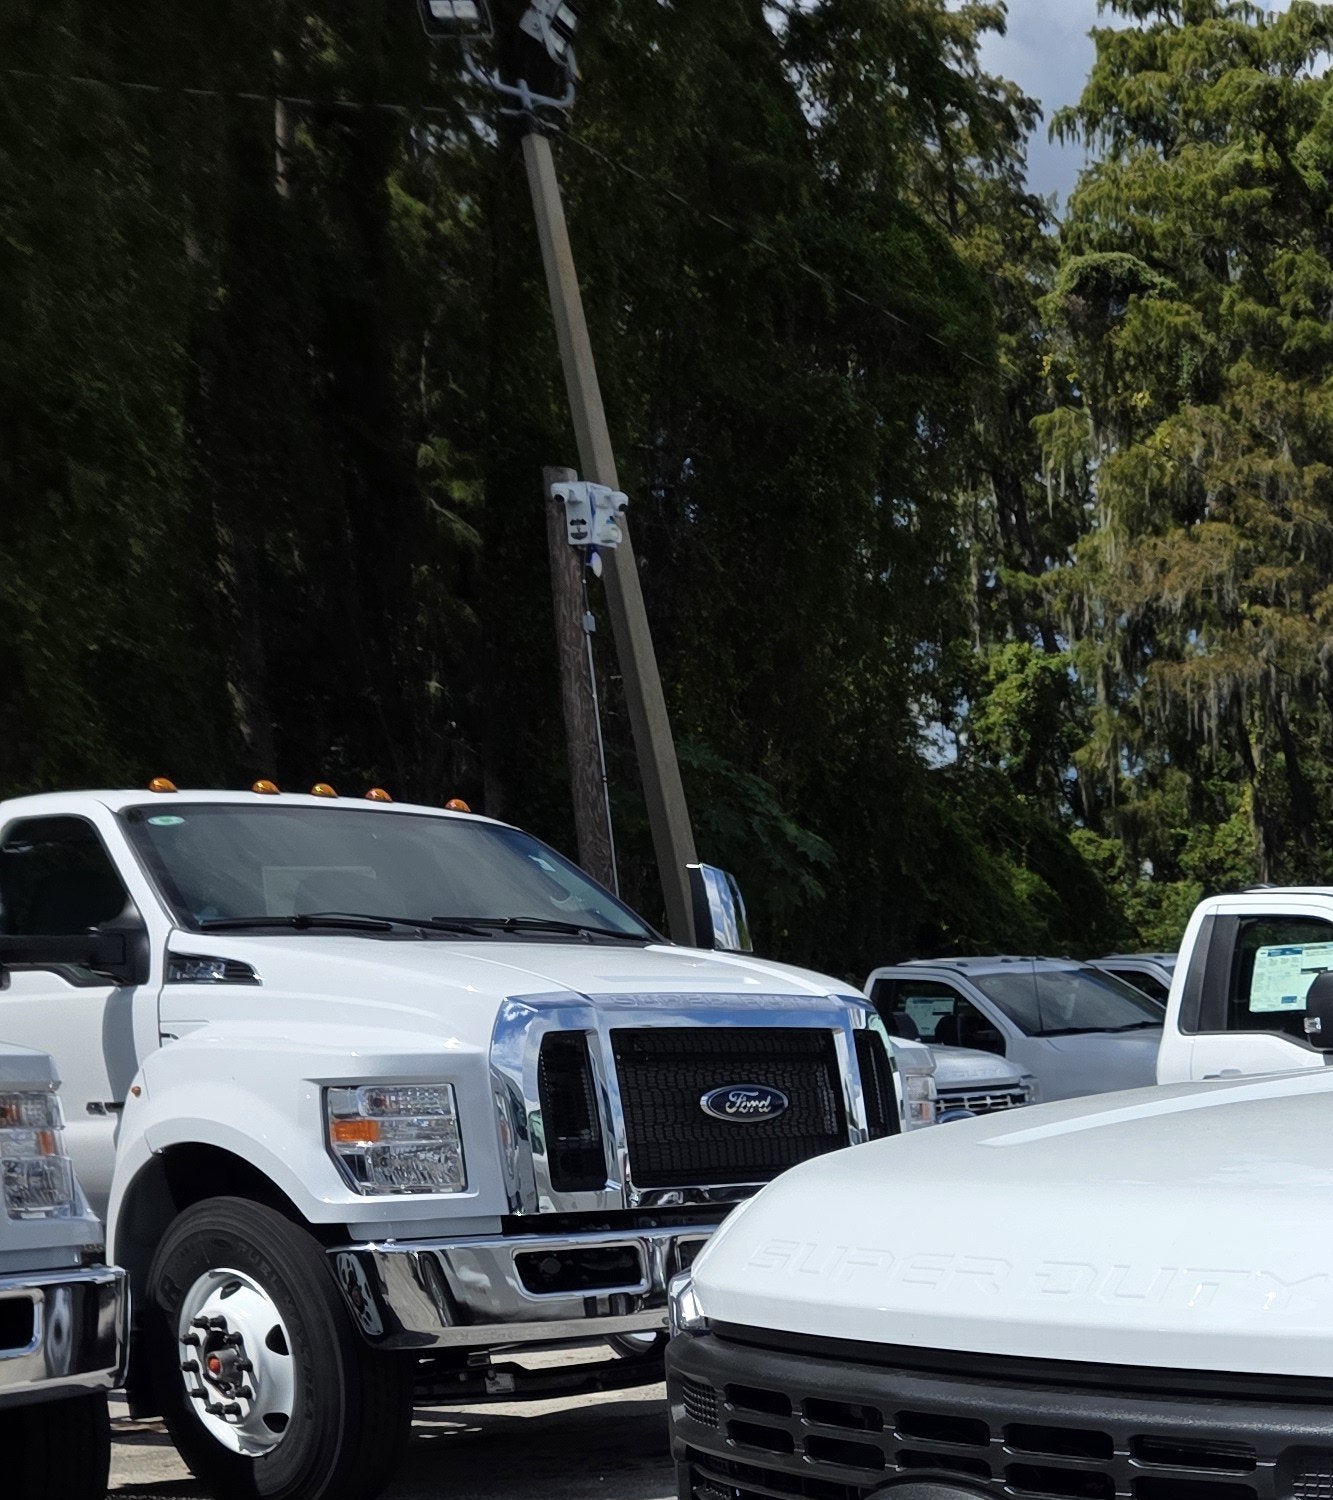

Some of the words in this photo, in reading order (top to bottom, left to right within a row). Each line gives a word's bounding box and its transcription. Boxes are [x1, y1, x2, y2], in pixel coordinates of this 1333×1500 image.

[726, 1090, 773, 1114] Ford
[743, 1237, 1014, 1295] SUPER
[1034, 1258, 1331, 1310] DUTY
